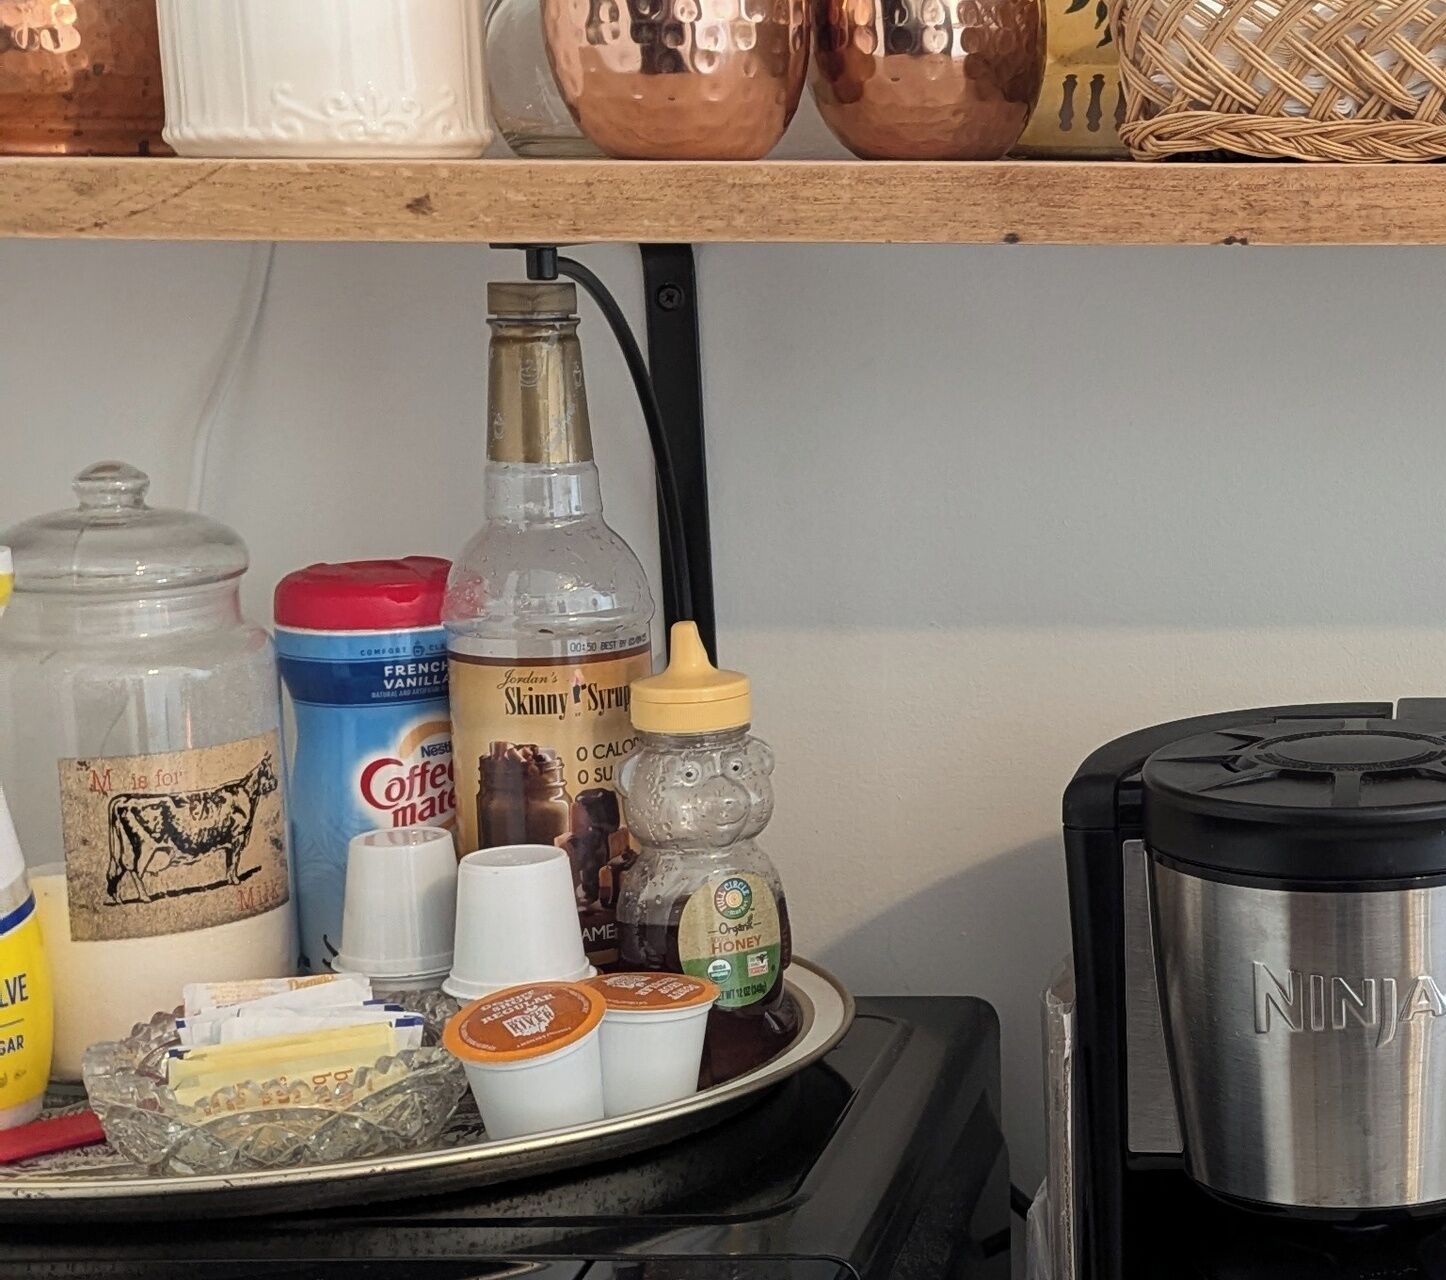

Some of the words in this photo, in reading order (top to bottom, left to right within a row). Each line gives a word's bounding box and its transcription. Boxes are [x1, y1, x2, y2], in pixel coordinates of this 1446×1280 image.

[497, 669, 558, 689] Jordan's
[505, 686, 568, 720] Skinny
[421, 740, 452, 758] Nest
[90, 769, 113, 796] M
[131, 772, 148, 791] is
[155, 768, 183, 788] for
[594, 765, 614, 784] SU
[237, 880, 280, 912] Milk
[582, 923, 615, 942] AME
[711, 934, 762, 955] HONEY
[0, 973, 29, 1009] LVE
[0, 1035, 24, 1056] GAR
